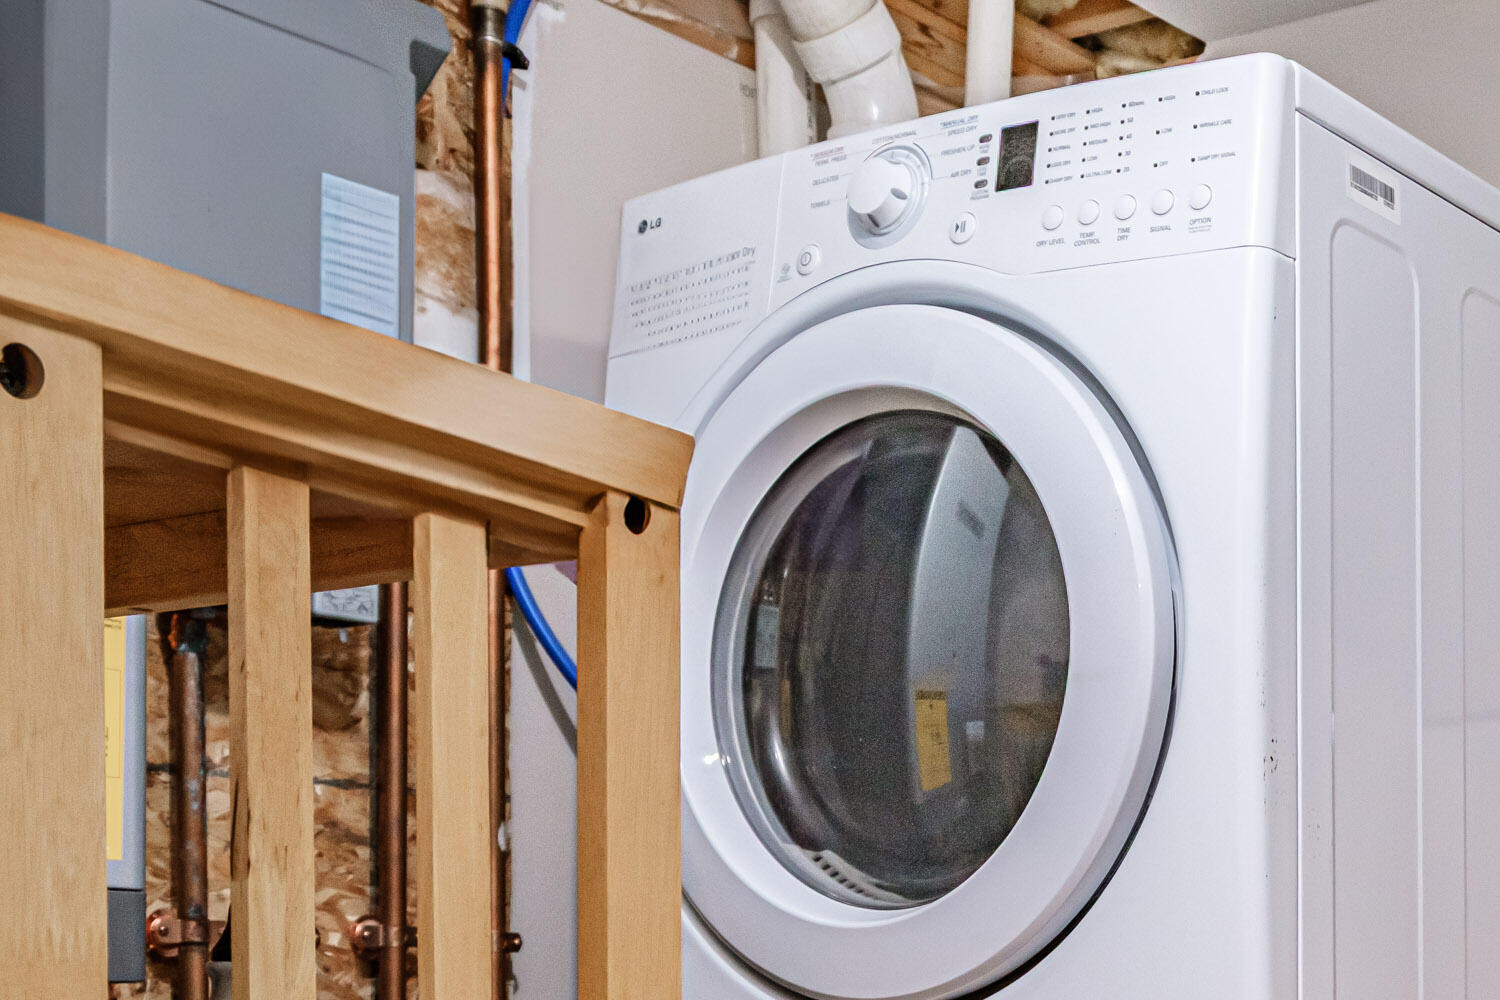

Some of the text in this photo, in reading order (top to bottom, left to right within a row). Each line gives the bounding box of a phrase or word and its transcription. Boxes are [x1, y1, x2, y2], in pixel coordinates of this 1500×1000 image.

[649, 217, 662, 230] LG
[1189, 217, 1212, 226] OPTION
[1117, 226, 1131, 234] TIME
[1149, 225, 1172, 233] SIGNAL
[1048, 237, 1065, 246] LEVEL
[1073, 237, 1101, 247] CONTROL
